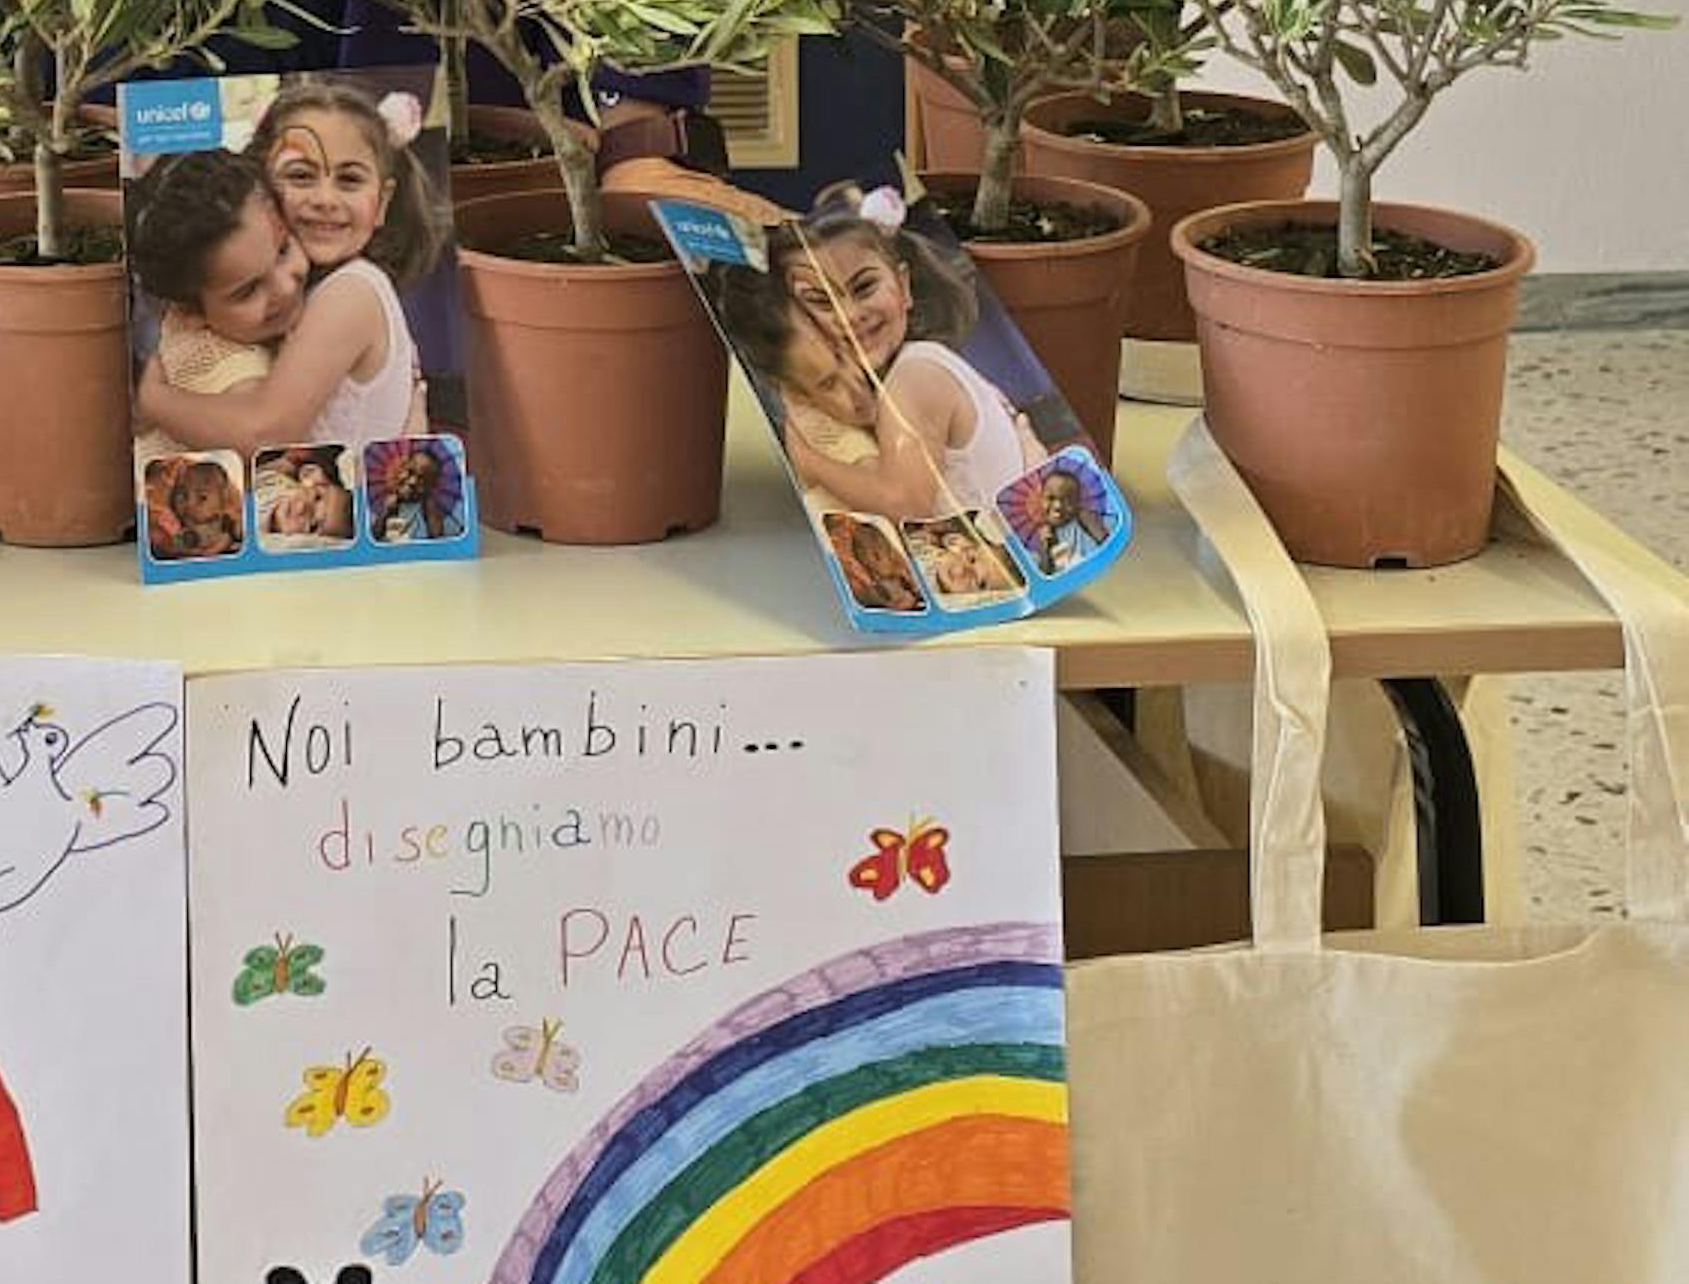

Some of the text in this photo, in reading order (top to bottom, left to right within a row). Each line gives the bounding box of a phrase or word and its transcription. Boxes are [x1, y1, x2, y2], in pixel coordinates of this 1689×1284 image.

[136, 102, 188, 124] unicef
[246, 689, 808, 791] Noi bambini...
[317, 798, 662, 898] disegniamo
[446, 908, 758, 1008] la PACE
